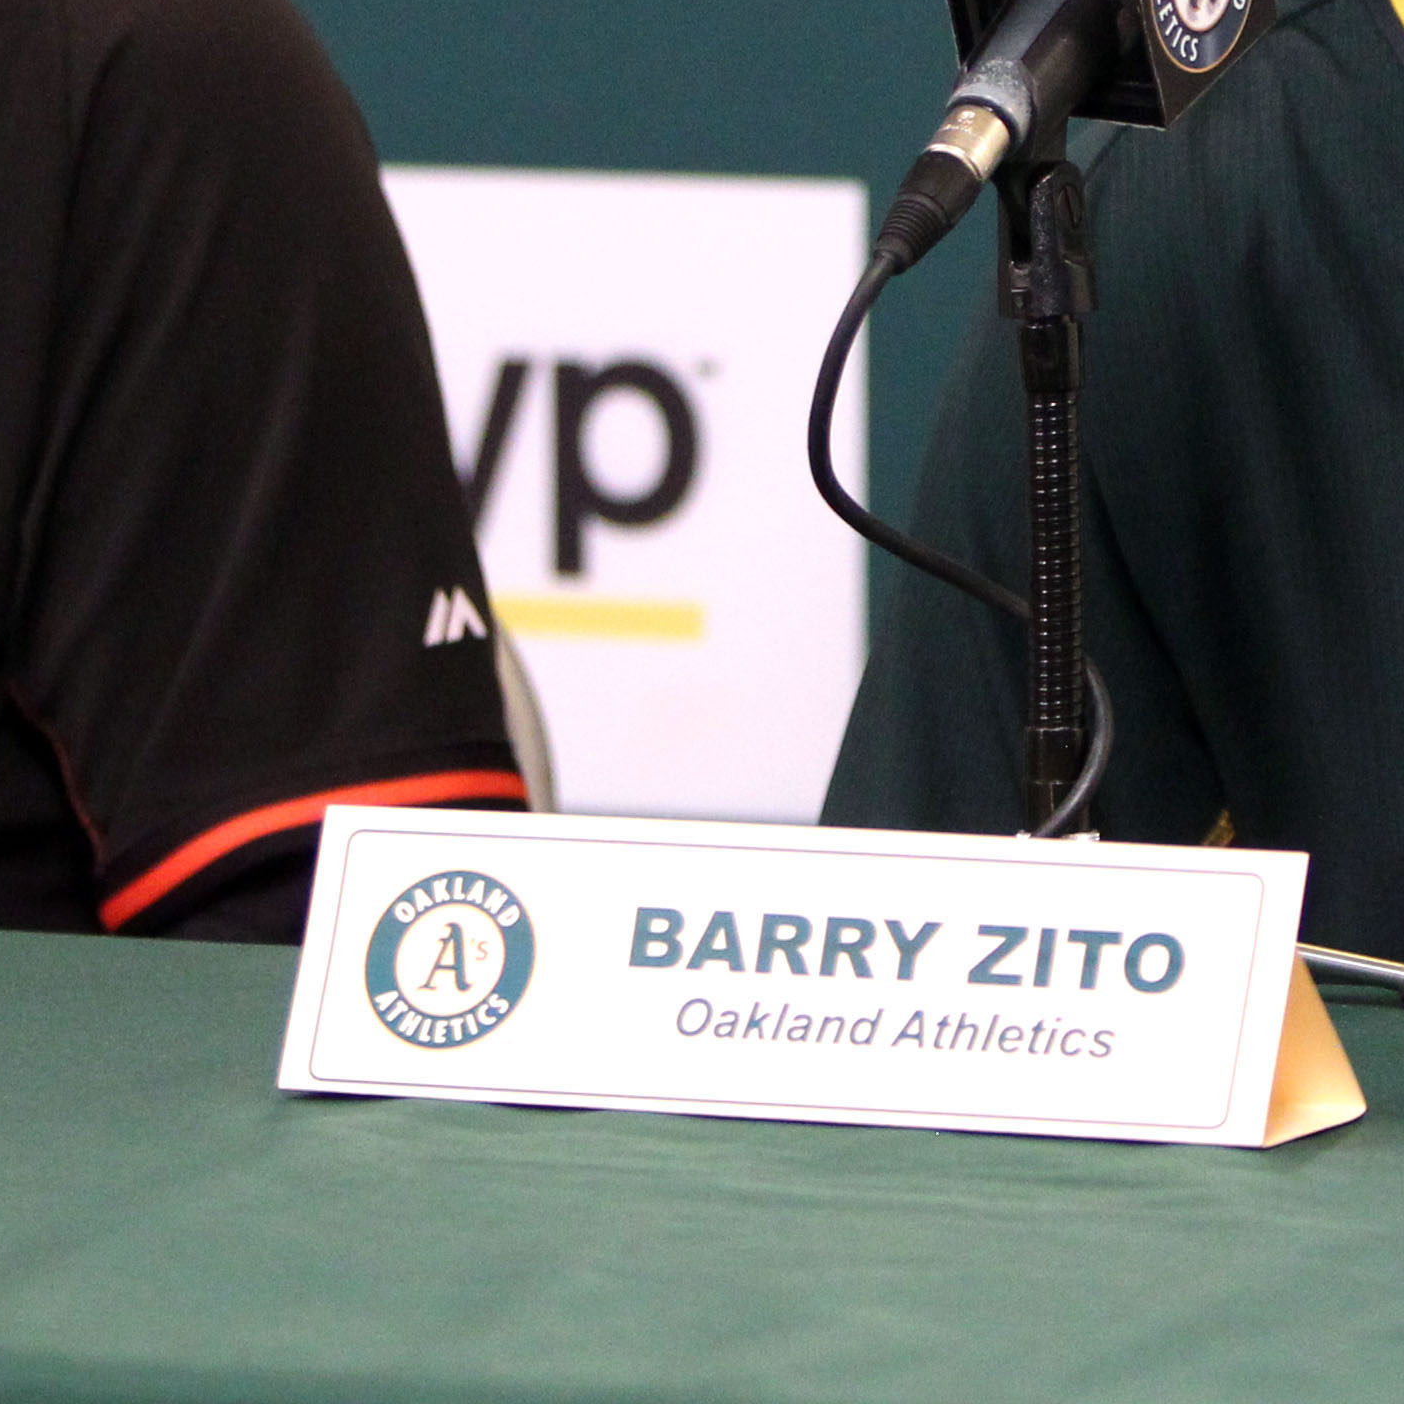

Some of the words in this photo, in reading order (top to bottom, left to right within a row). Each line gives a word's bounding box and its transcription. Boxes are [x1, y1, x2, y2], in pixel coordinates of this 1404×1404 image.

[394, 876, 521, 927] OAKLAND
[417, 922, 489, 992] A's
[628, 906, 944, 982] BARRY
[967, 924, 1186, 995] ZITO
[373, 990, 510, 1044] ATHLETICS
[675, 998, 885, 1046] Oakland
[891, 1009, 1116, 1058] Athletics
